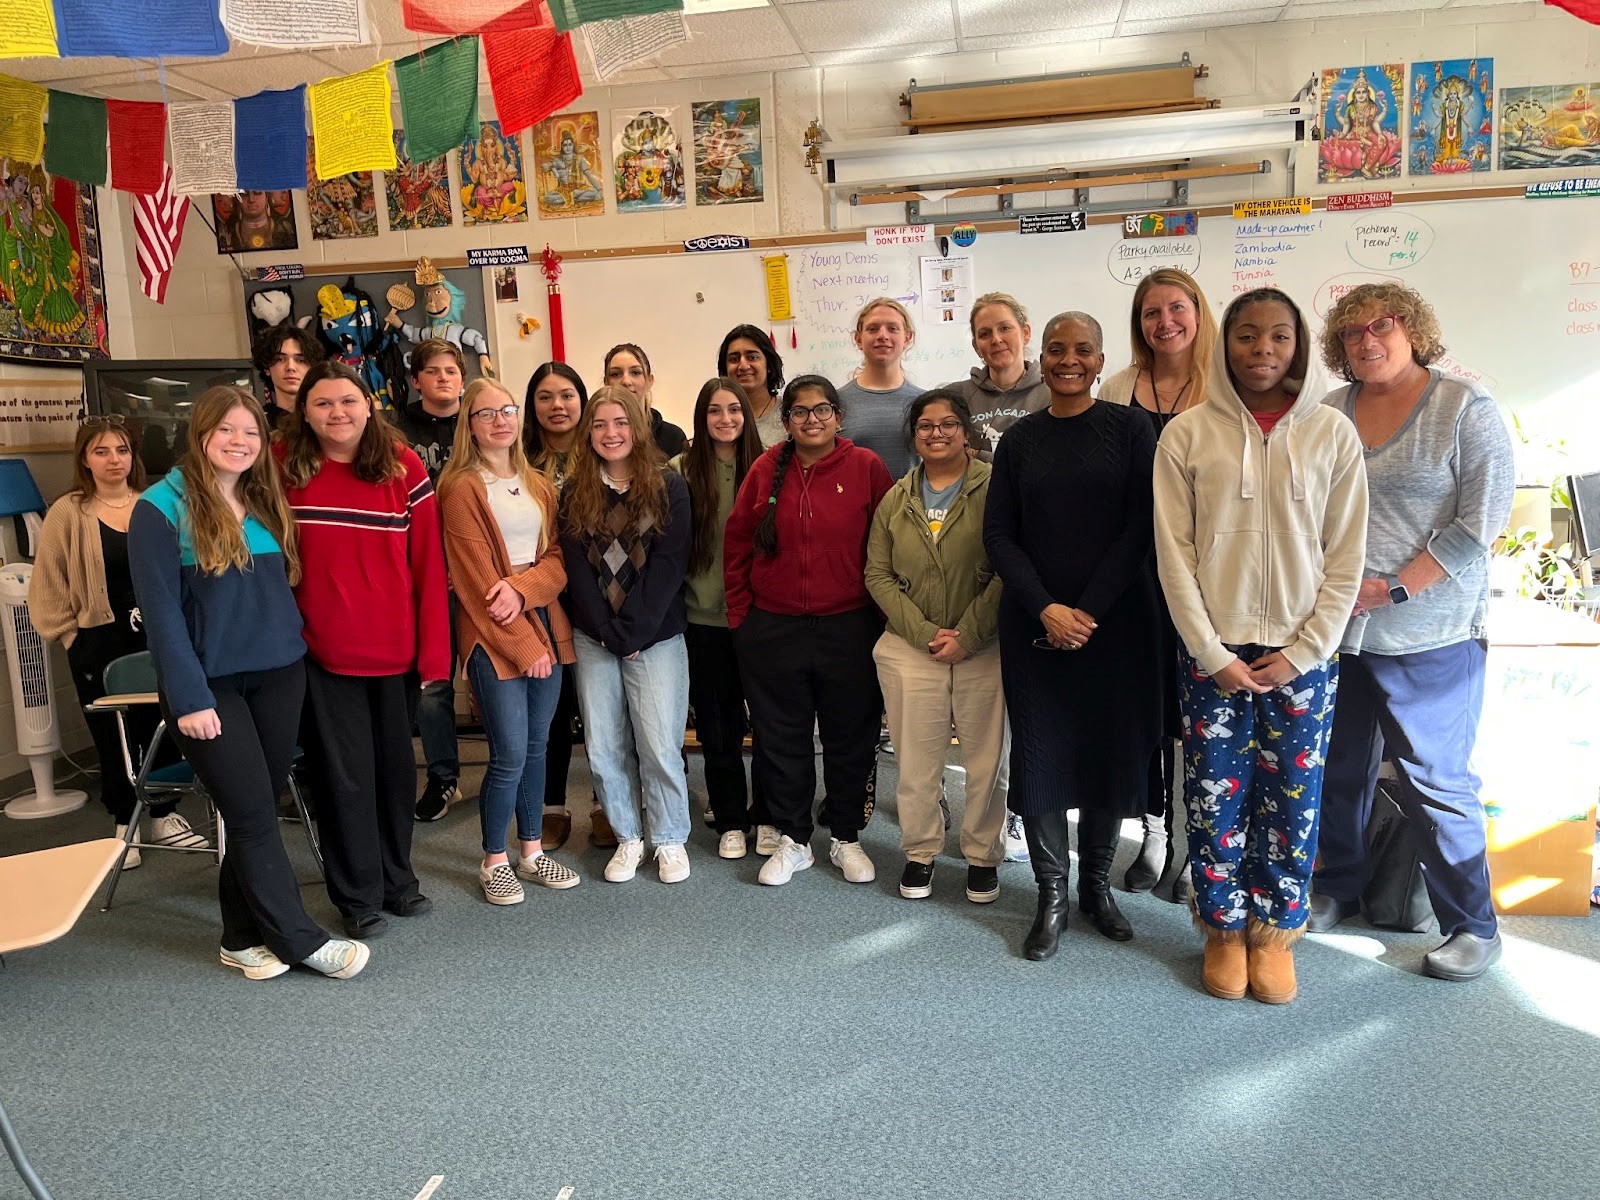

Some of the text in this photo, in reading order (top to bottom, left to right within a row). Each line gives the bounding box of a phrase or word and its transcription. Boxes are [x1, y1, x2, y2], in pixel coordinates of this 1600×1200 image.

[1539, 180, 1563, 191] REFUSE
[1564, 180, 1574, 190] TO
[1575, 179, 1584, 190] BE
[1234, 197, 1311, 210] MY OTHER VEHICLE IS
[1328, 193, 1390, 205] ZEN BUDDHISM
[1244, 206, 1301, 218] THE MAHAYANA
[874, 227, 897, 236] HONK
[909, 225, 926, 234] YOU
[954, 230, 976, 240] ALLY
[1236, 222, 1278, 236] Made-up
[876, 236, 924, 245] DON'T EXIST
[1403, 230, 1419, 247] 14
[471, 247, 523, 258] MY KARMA RAN
[1148, 242, 1194, 256] available
[1234, 241, 1296, 254] Zambodia
[500, 255, 528, 264] DOGMA
[811, 251, 878, 271] Young Dems
[1234, 257, 1277, 269] Nambia
[1568, 262, 1591, 279] B7
[813, 274, 889, 290] Next meeting
[1567, 297, 1598, 313] class
[1566, 320, 1595, 336] class
[9, 397, 17, 406] of
[21, 397, 32, 406] the
[34, 399, 63, 409] greatest
[25, 413, 34, 422] is
[35, 413, 47, 422] the
[48, 412, 64, 424] pain
[65, 412, 73, 421] of
